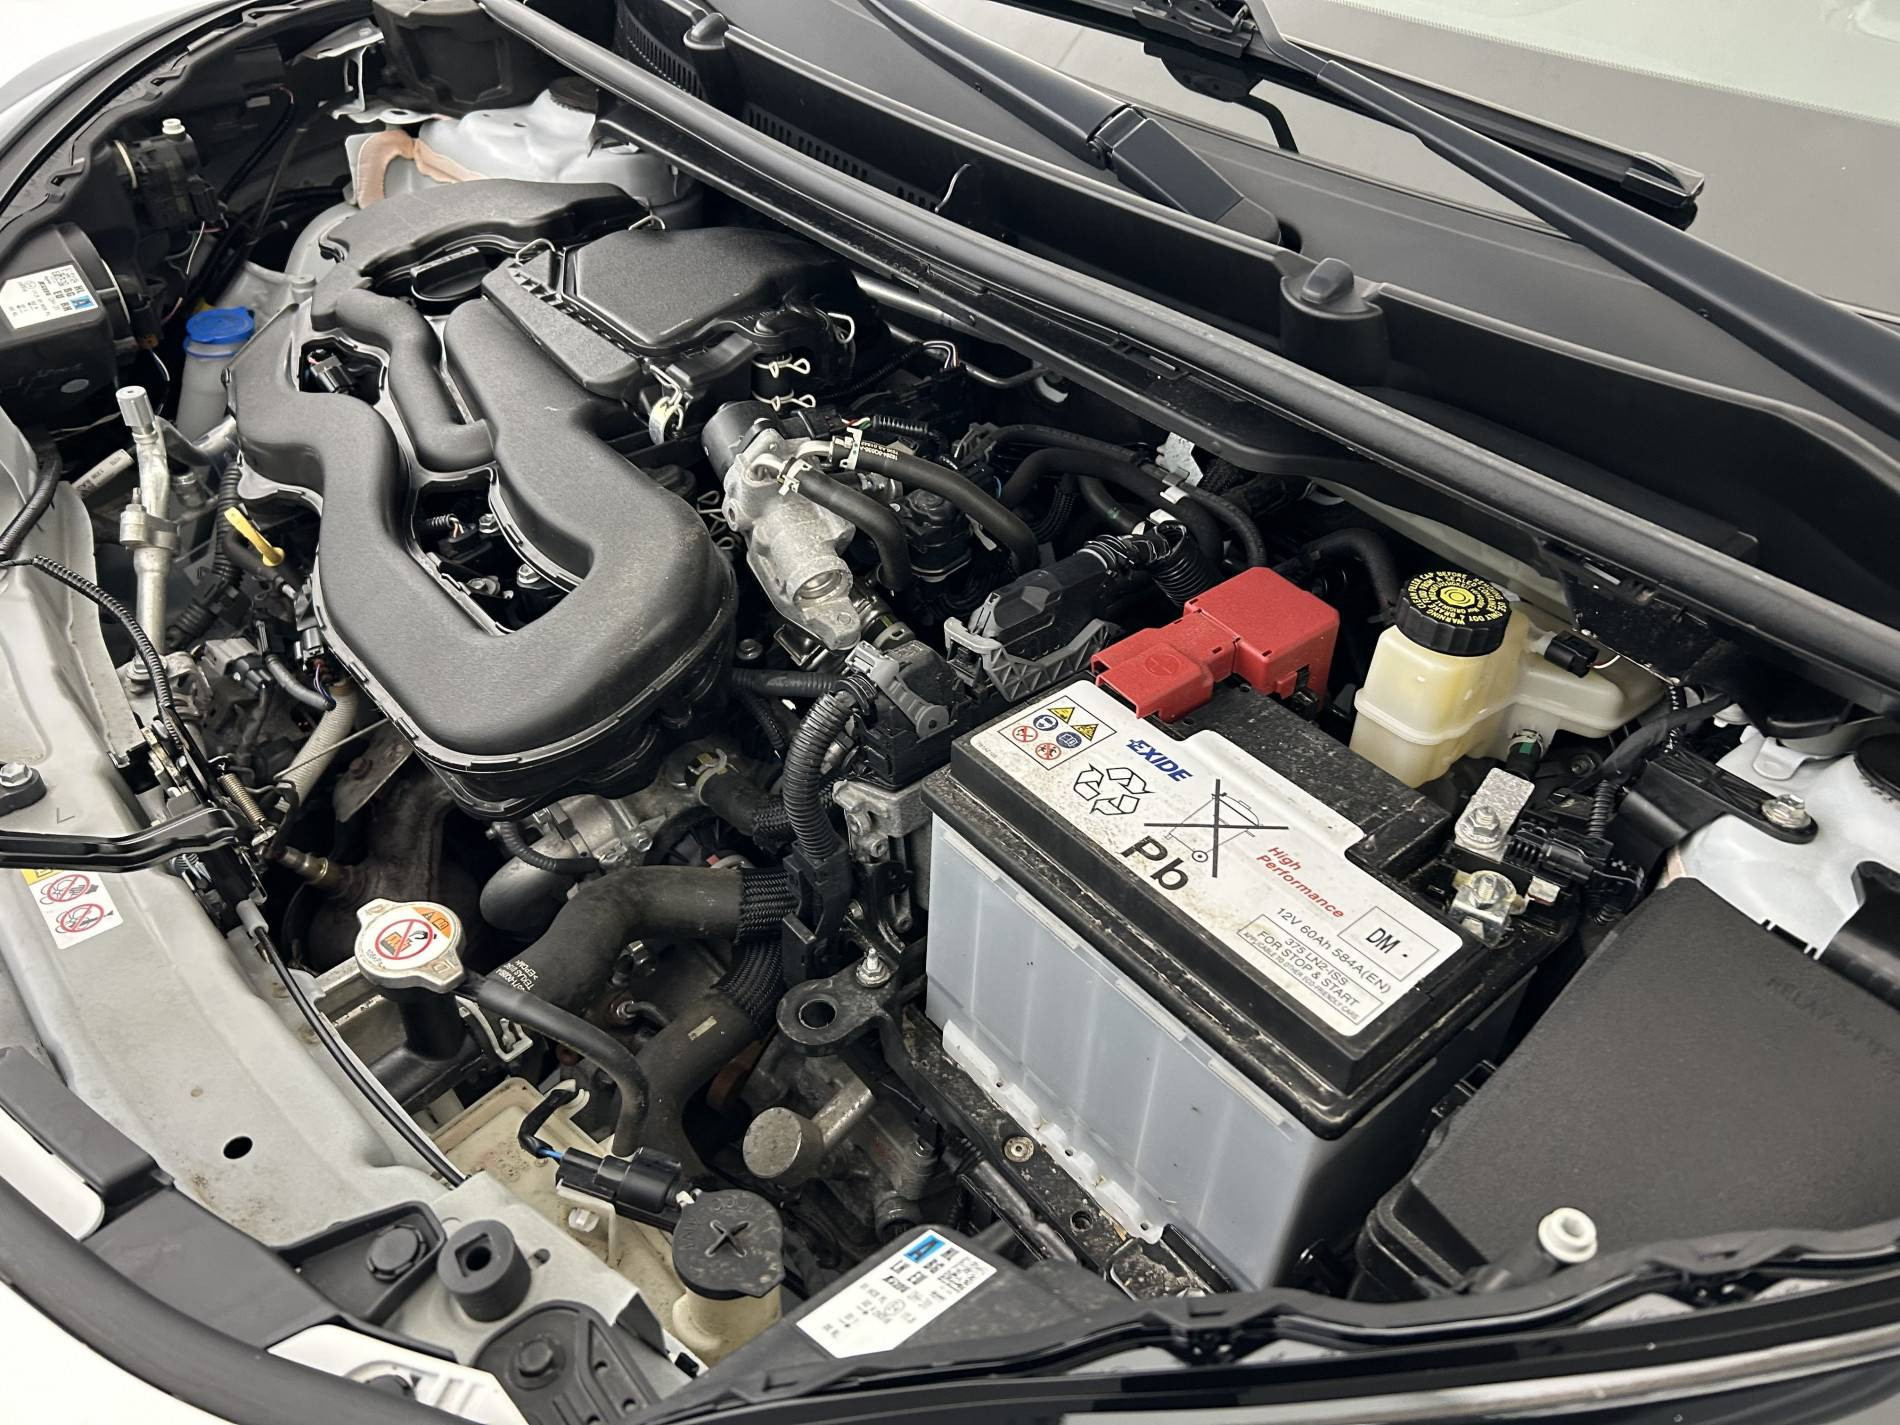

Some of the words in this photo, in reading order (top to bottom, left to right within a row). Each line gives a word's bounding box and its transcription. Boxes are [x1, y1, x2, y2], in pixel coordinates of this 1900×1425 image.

[1428, 602, 1456, 618] BRAKE
[1445, 576, 1476, 587] SEALED
[1436, 572, 1468, 580] BEFORE
[1410, 592, 1426, 608] CLEAN
[1426, 609, 1466, 625] WARNING
[1126, 739, 1194, 782] EXIDE
[1120, 836, 1189, 890] Pb
[1268, 847, 1302, 872] High
[1256, 854, 1344, 918] Performance
[1243, 932, 1277, 958] APPLICABLE
[1283, 962, 1303, 978] OTHER
[1276, 908, 1302, 926] 12V
[1300, 924, 1332, 950] 60Ah
[1331, 948, 1391, 994] 584A(EN)
[1284, 938, 1306, 954] 375
[1305, 952, 1349, 986] LN2-ISS
[1366, 928, 1400, 954] DM
[1257, 930, 1282, 952] FOR
[1282, 948, 1313, 972] STOP
[1312, 971, 1319, 980] &
[1320, 976, 1360, 1006] START
